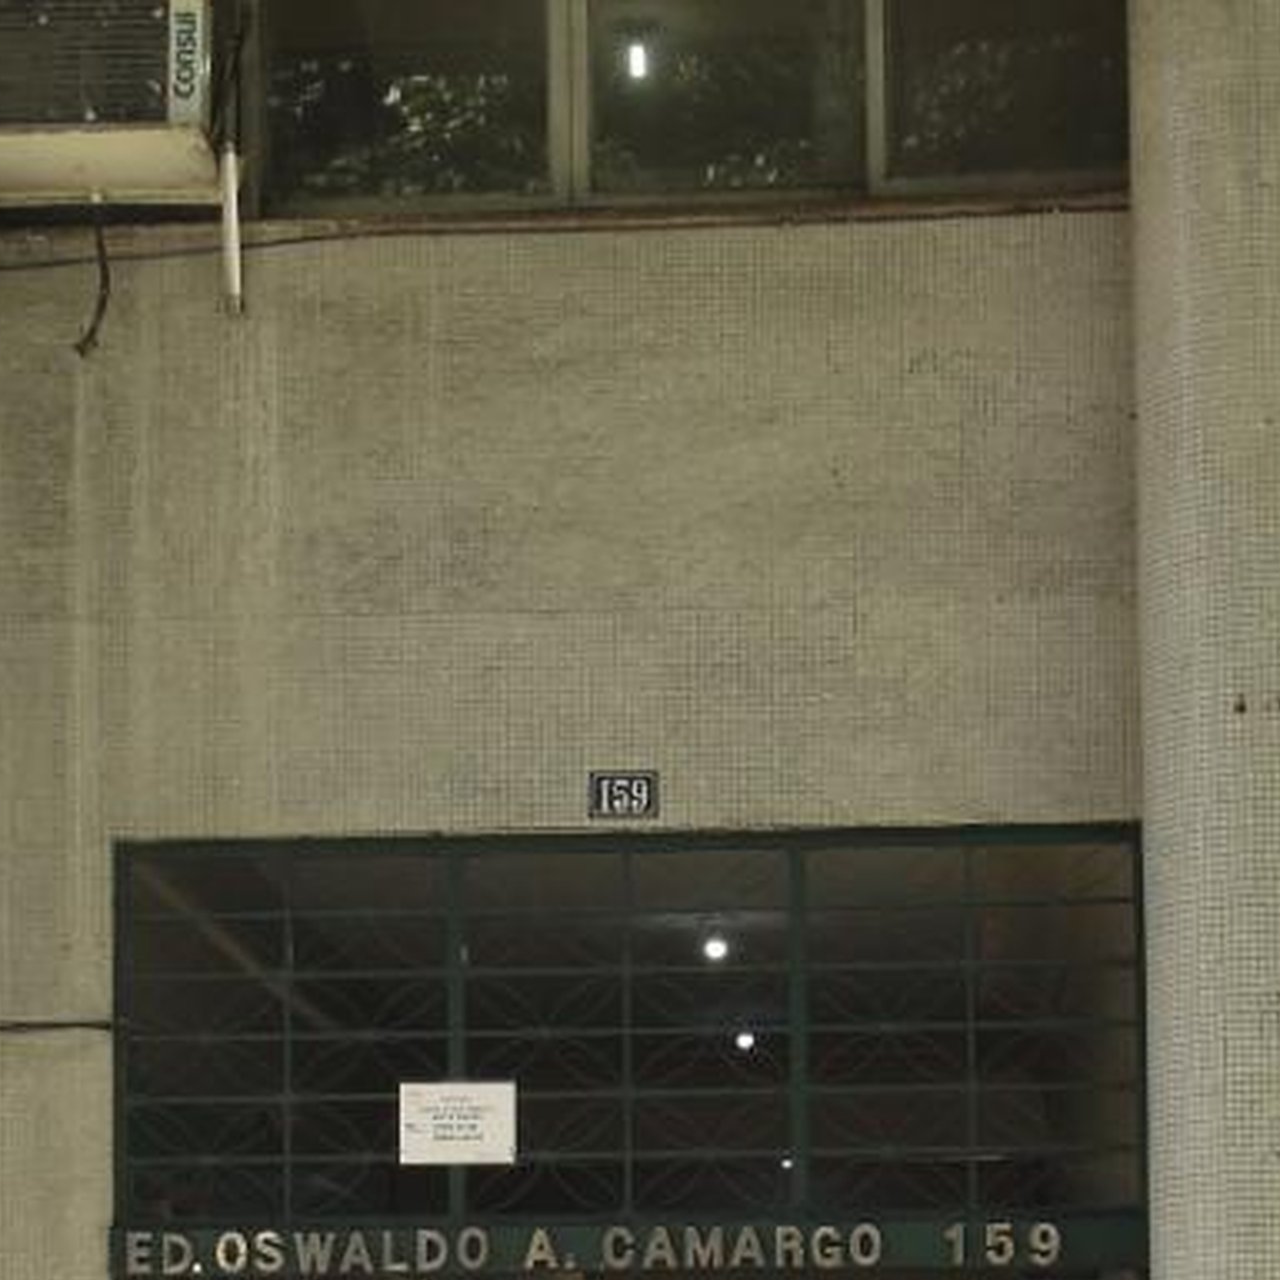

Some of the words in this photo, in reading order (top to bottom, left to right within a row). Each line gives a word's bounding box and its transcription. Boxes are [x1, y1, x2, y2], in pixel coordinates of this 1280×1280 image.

[600, 779, 648, 814] 159
[216, 1227, 490, 1274] OSWALDO
[525, 1227, 578, 1270] A.
[602, 1222, 883, 1272] CAMARGO
[944, 1222, 1062, 1267] 159
